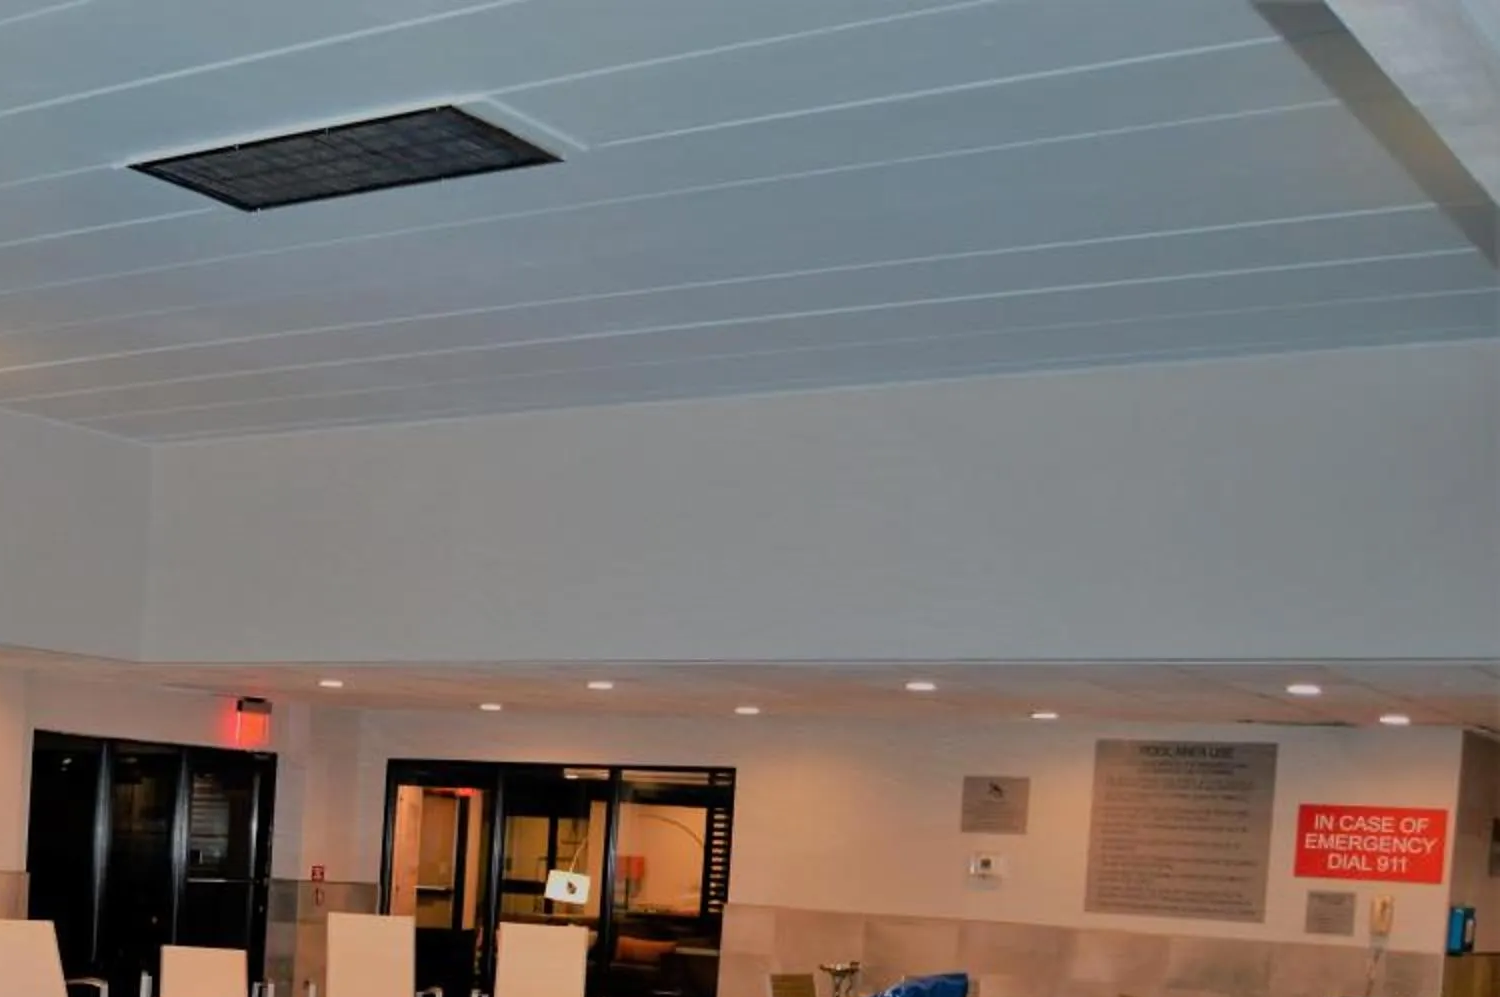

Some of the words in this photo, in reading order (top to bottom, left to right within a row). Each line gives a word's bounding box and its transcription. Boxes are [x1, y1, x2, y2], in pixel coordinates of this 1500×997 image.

[1314, 814, 1334, 831] IN
[1339, 815, 1395, 833] CASE
[1400, 817, 1429, 834] OF
[1304, 833, 1438, 855] EMERGENCY
[1327, 853, 1373, 872] DIAL
[1377, 856, 1408, 874] 911
